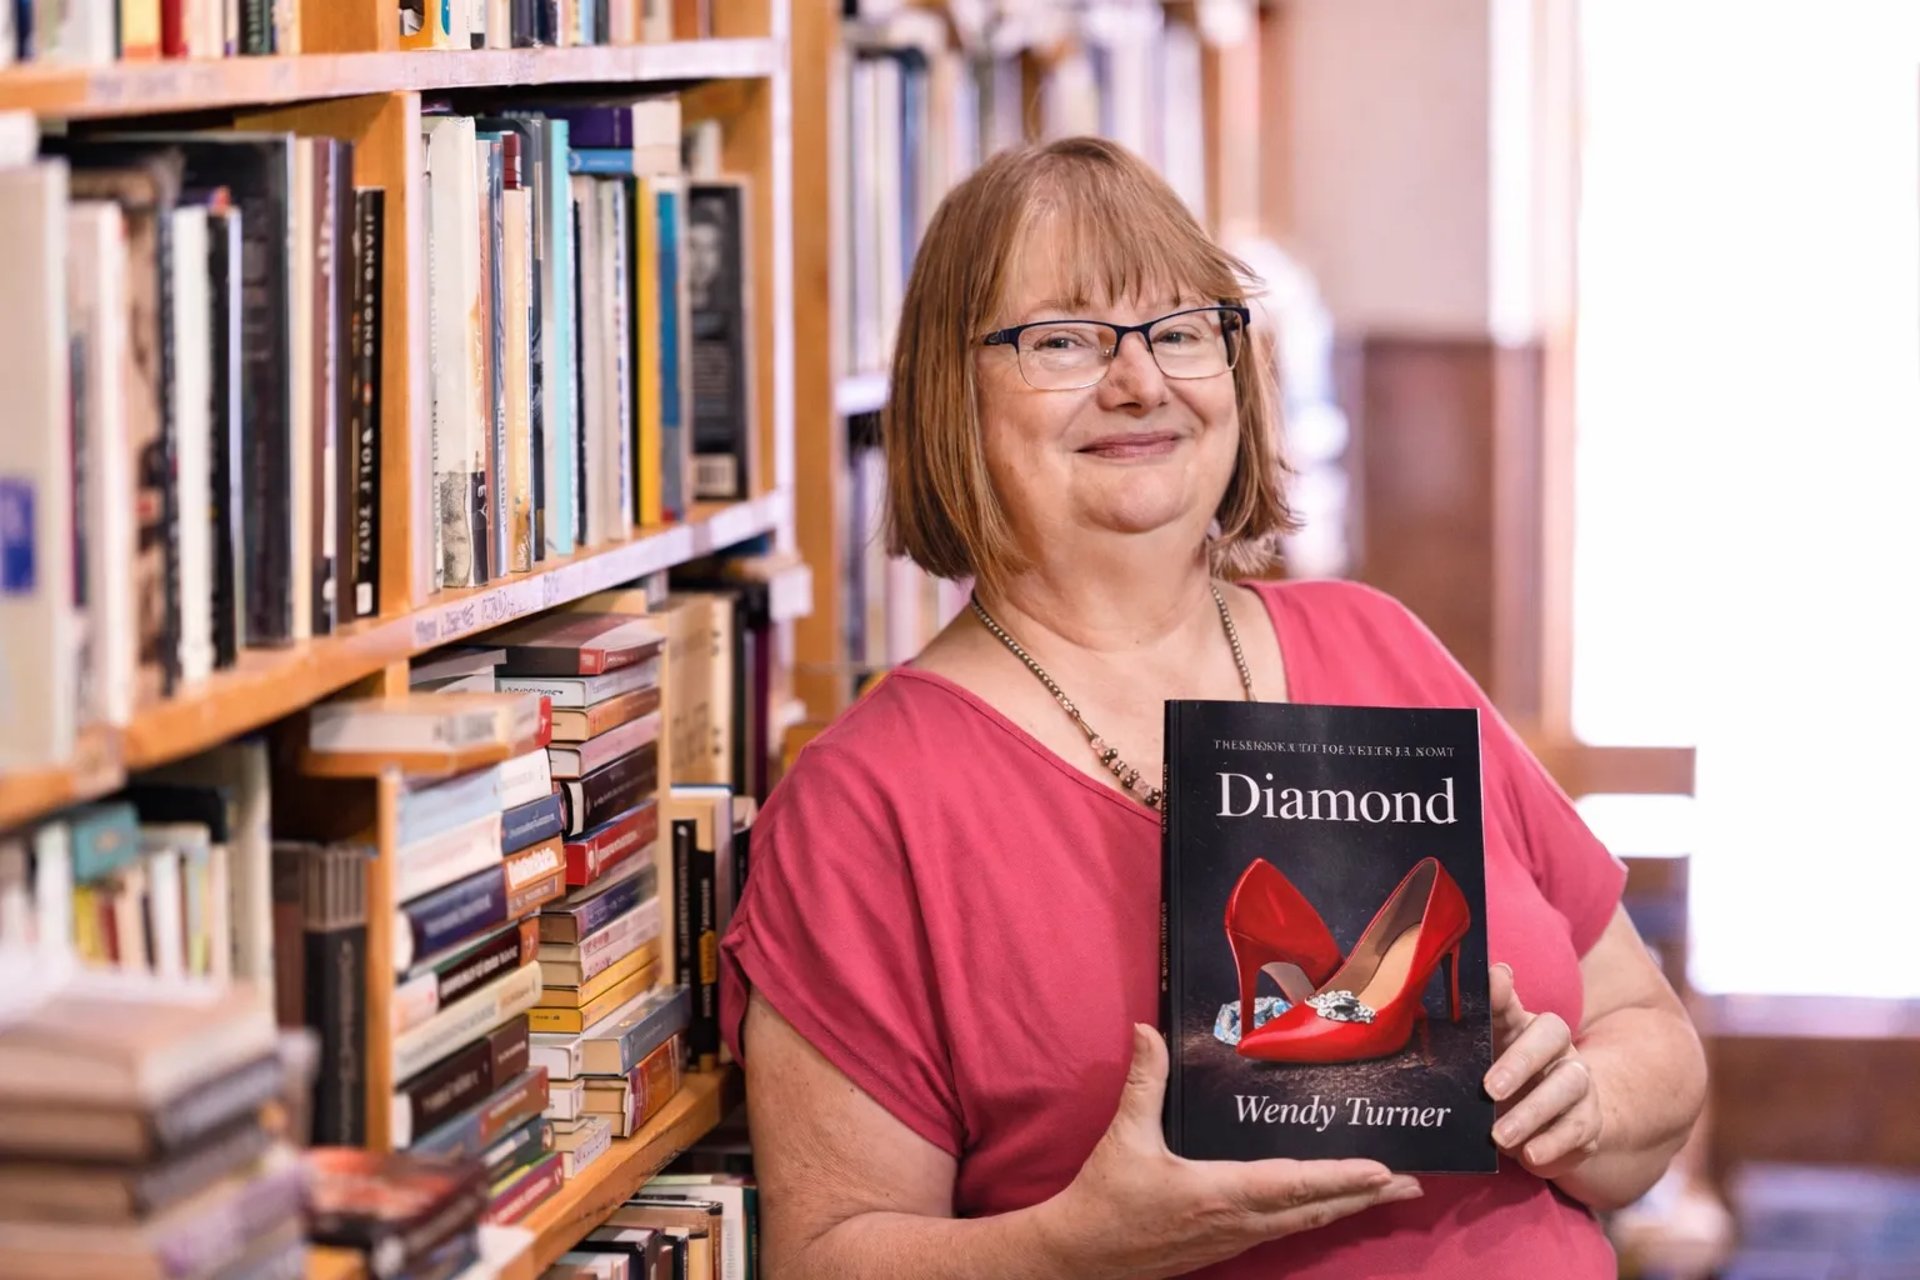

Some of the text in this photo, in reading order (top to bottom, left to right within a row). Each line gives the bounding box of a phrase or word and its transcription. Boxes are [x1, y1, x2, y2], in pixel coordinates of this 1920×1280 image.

[1216, 772, 1458, 825] Diamond
[1234, 1094, 1451, 1132] Wendy Turner
